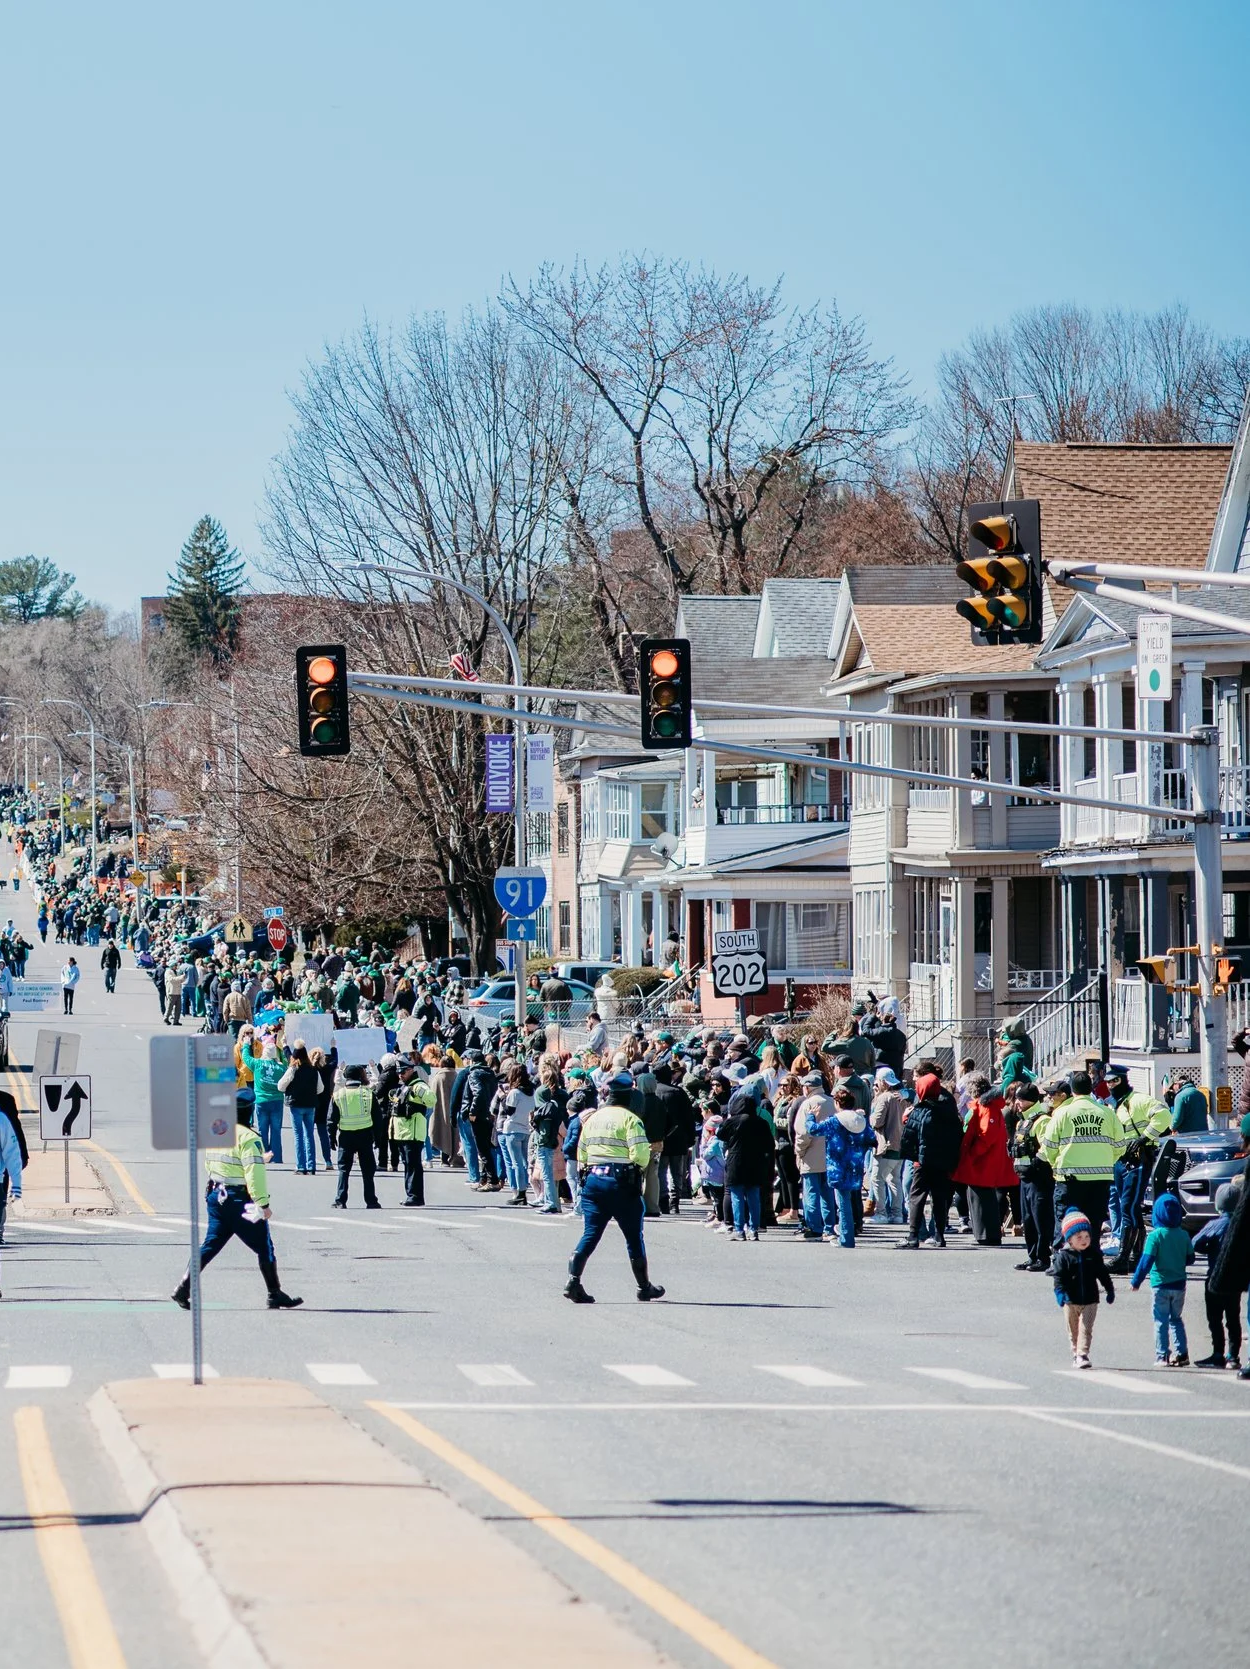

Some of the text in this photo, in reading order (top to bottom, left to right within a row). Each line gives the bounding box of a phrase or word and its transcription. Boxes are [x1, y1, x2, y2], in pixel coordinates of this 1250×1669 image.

[1146, 637, 1164, 649] YIELD
[1152, 653, 1168, 664] GREEN
[488, 740, 510, 806] HOLYOKE
[505, 879, 533, 907] 91
[269, 927, 285, 941] STOP
[719, 934, 755, 948] SOUTH
[717, 961, 762, 988] 202
[1071, 1114, 1104, 1127] HOLYOKE
[1075, 1126, 1102, 1136] POLICE
